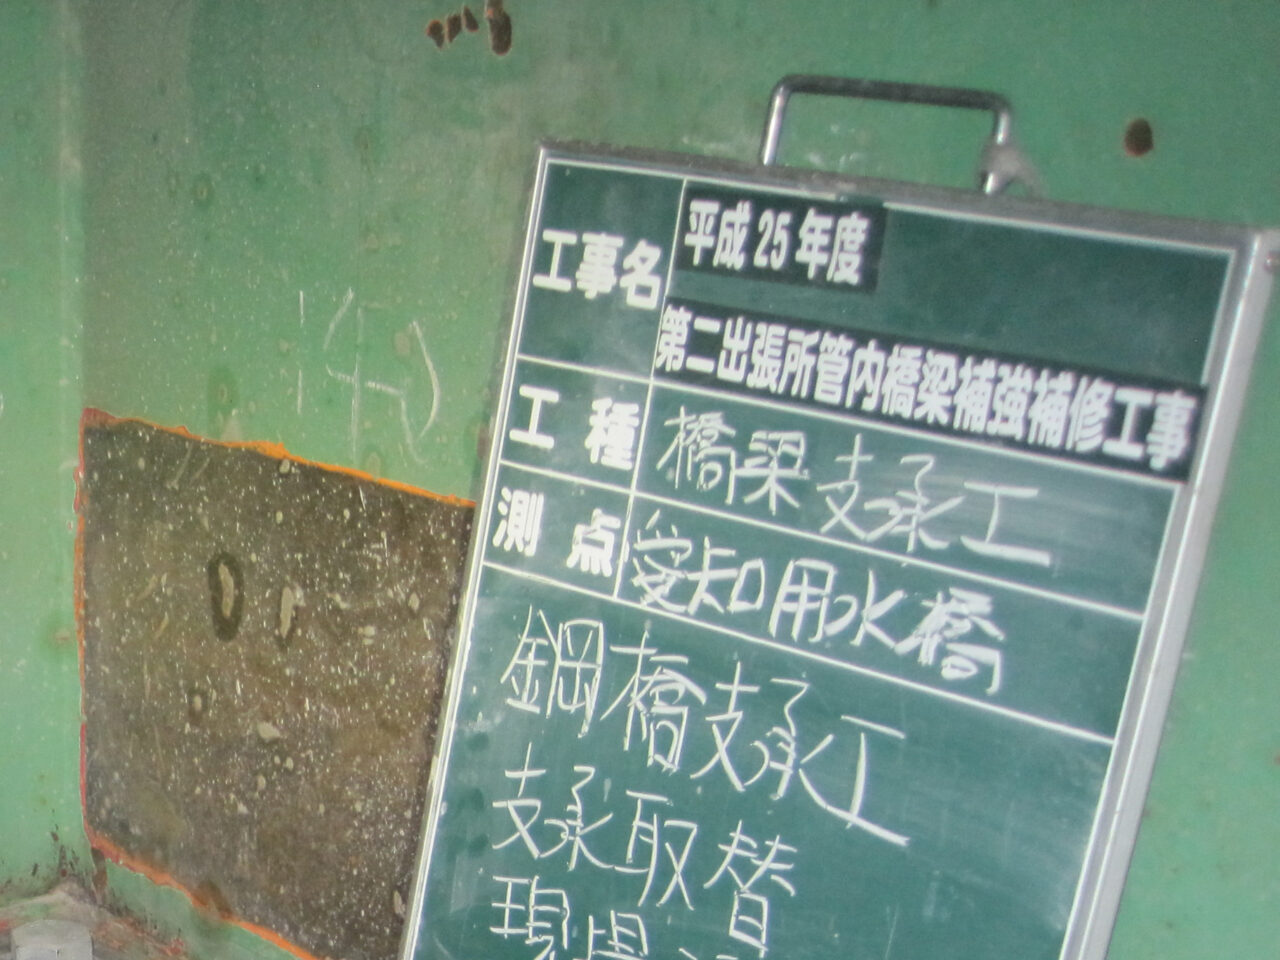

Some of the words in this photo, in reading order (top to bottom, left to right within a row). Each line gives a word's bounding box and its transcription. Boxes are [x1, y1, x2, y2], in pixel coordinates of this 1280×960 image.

[533, 228, 662, 310] 工事名
[683, 199, 869, 286] 平成25年度
[509, 385, 640, 470] 工種
[655, 304, 1197, 471] 第二出張所管内橋梁補強補修工事
[493, 488, 622, 578] 測点
[657, 405, 1052, 567] 橋梁支承工
[631, 510, 1006, 695] 愛知用水橋
[500, 604, 910, 847] 鋼橋支承工
[492, 742, 797, 960] 支承取替
